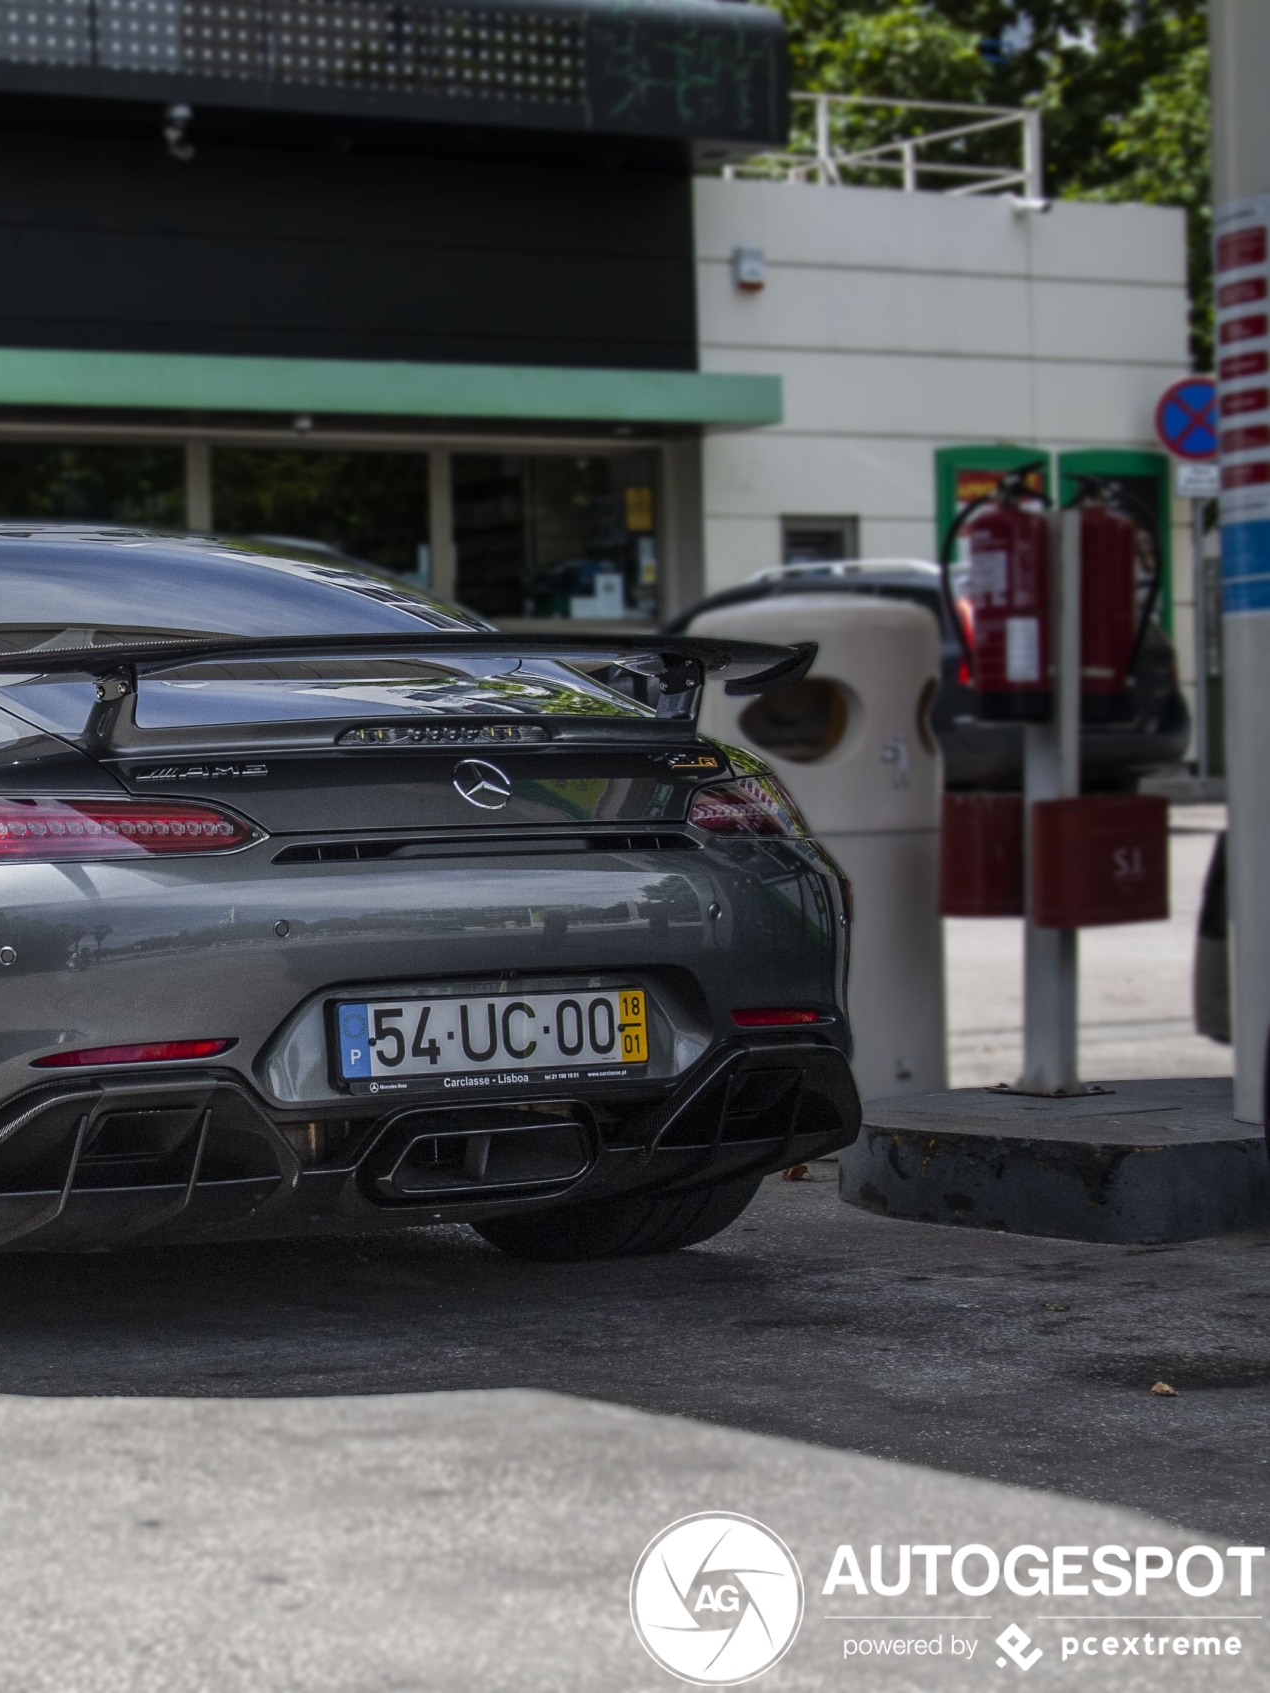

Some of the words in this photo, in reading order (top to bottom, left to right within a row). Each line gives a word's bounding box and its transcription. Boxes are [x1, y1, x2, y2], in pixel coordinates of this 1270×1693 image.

[621, 995, 641, 1018] 18
[623, 1033, 642, 1055] 01
[349, 1049, 363, 1066] P
[443, 1076, 490, 1088] Carclasse
[497, 1073, 529, 1085] Lisboa
